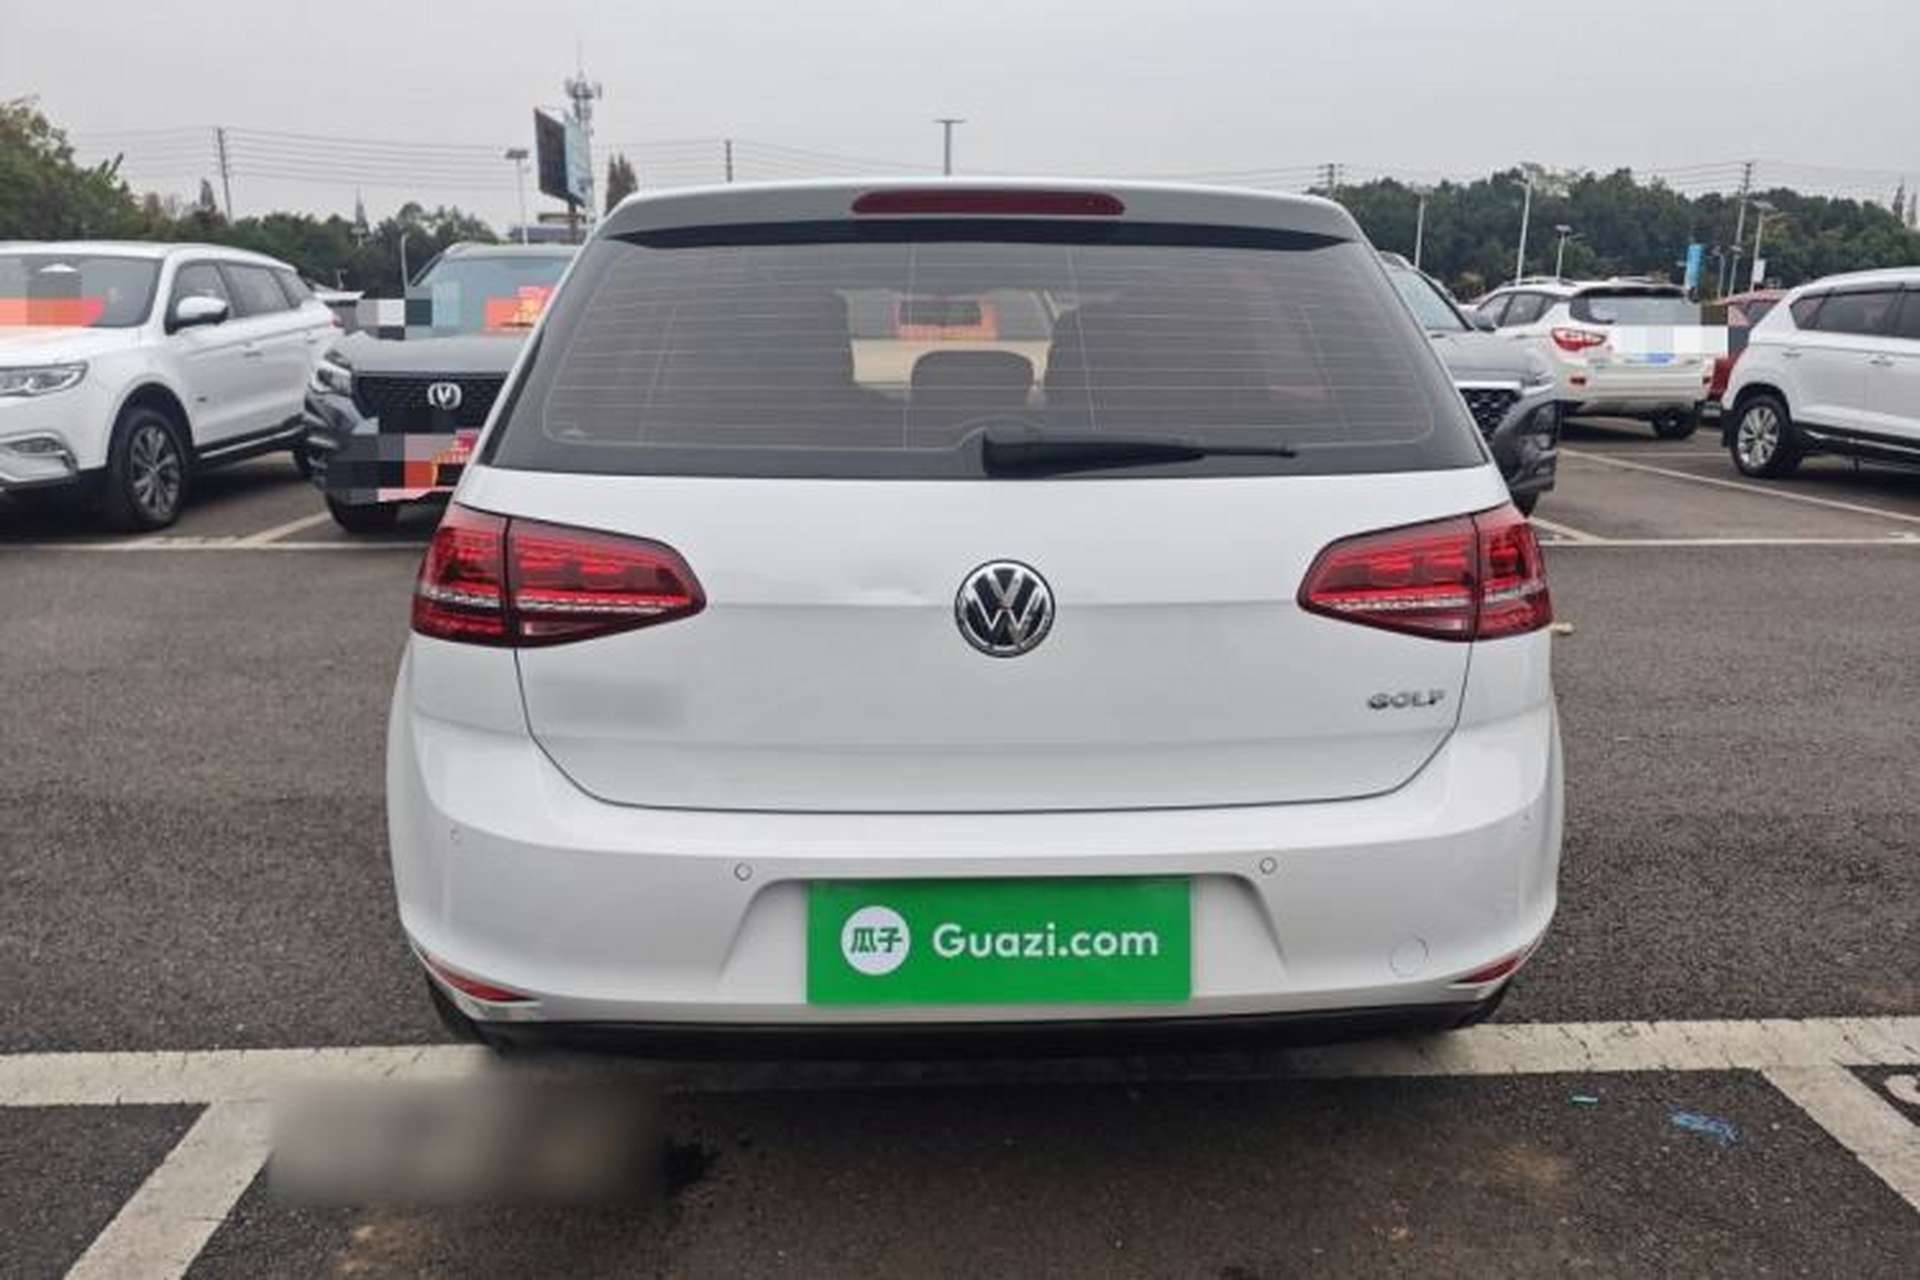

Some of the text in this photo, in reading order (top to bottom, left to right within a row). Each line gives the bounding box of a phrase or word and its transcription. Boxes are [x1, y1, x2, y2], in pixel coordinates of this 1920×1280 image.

[1368, 690, 1446, 710] GOLF
[851, 927, 903, 953] 瓜子
[932, 922, 1160, 958] Guazi.com
